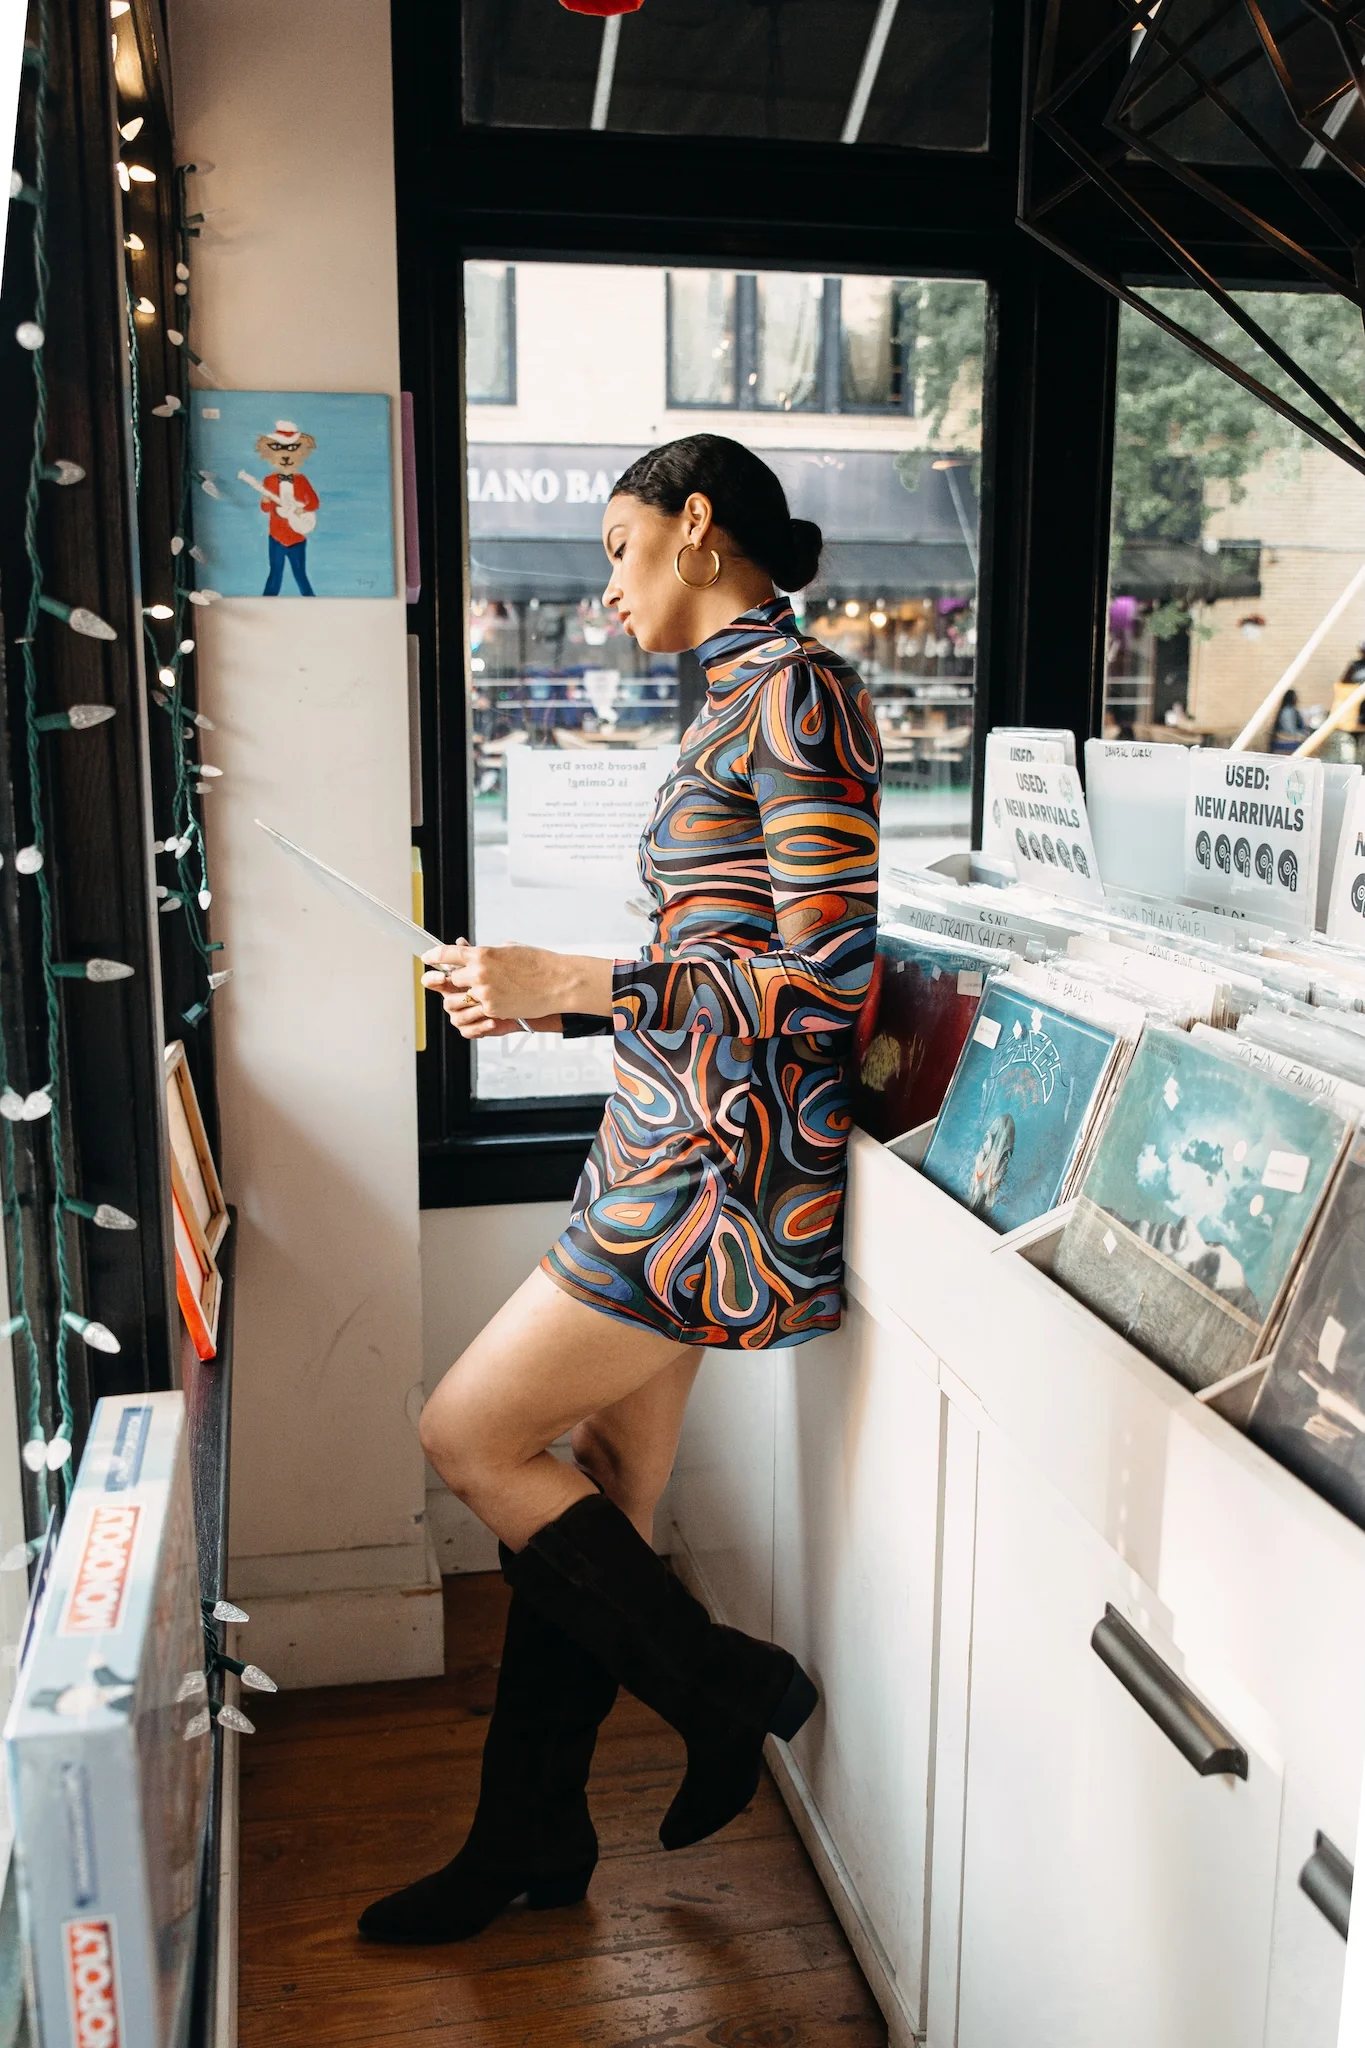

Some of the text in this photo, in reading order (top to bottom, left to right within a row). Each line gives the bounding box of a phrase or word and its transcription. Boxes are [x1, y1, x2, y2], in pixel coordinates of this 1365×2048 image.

[1015, 772, 1048, 795] USED:
[1225, 764, 1270, 791] USED:
[1004, 798, 1080, 829] NEW ARRIVALS
[1194, 795, 1304, 832] NEW ARRIVALS
[1279, 1060, 1341, 1097] LENNON
[75, 1507, 137, 1630] MONOPOLY
